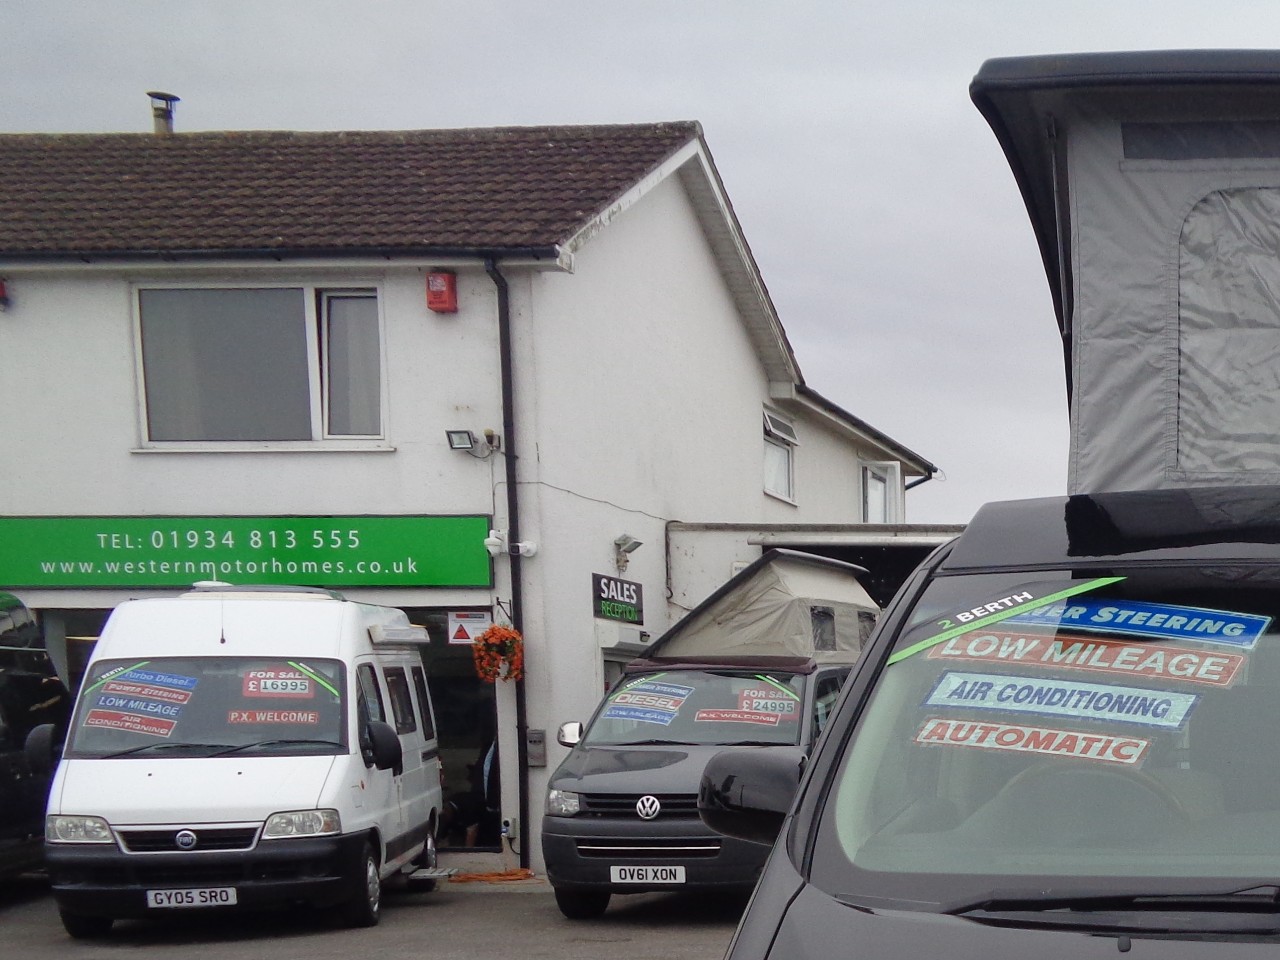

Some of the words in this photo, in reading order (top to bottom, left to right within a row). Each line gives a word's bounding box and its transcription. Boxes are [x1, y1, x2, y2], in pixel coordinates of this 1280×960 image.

[97, 533, 143, 549] TEL:
[151, 530, 235, 549] 01934
[249, 530, 297, 548] 813
[312, 530, 361, 548] 555
[41, 556, 419, 574] www.westernmotorhomes.co.uk
[600, 577, 637, 604] SALES
[601, 601, 638, 621] RECEPTION
[937, 619, 956, 630] 2
[956, 591, 1034, 623] BERTH
[1090, 606, 1247, 637] STEERING
[940, 635, 1043, 660] LOW
[1041, 640, 1230, 681] MILEAGE
[249, 671, 275, 679] FOR
[614, 693, 676, 709] DIESEL
[743, 689, 766, 698] FOR
[946, 680, 994, 701] AIR
[996, 683, 1172, 719] CONDITIONING
[99, 696, 128, 707] LOW
[128, 701, 179, 716] MILEAGE
[88, 718, 169, 734] CONDITIONING
[121, 715, 141, 723] AIR
[230, 712, 253, 721] P.X.
[256, 712, 316, 723] WELCOME
[720, 713, 777, 722] WELCOME
[923, 722, 1141, 760] AUTOMATIC
[619, 868, 648, 880] OV61
[652, 868, 677, 880] XON
[154, 891, 195, 905] GY05
[199, 889, 230, 903] SRO
